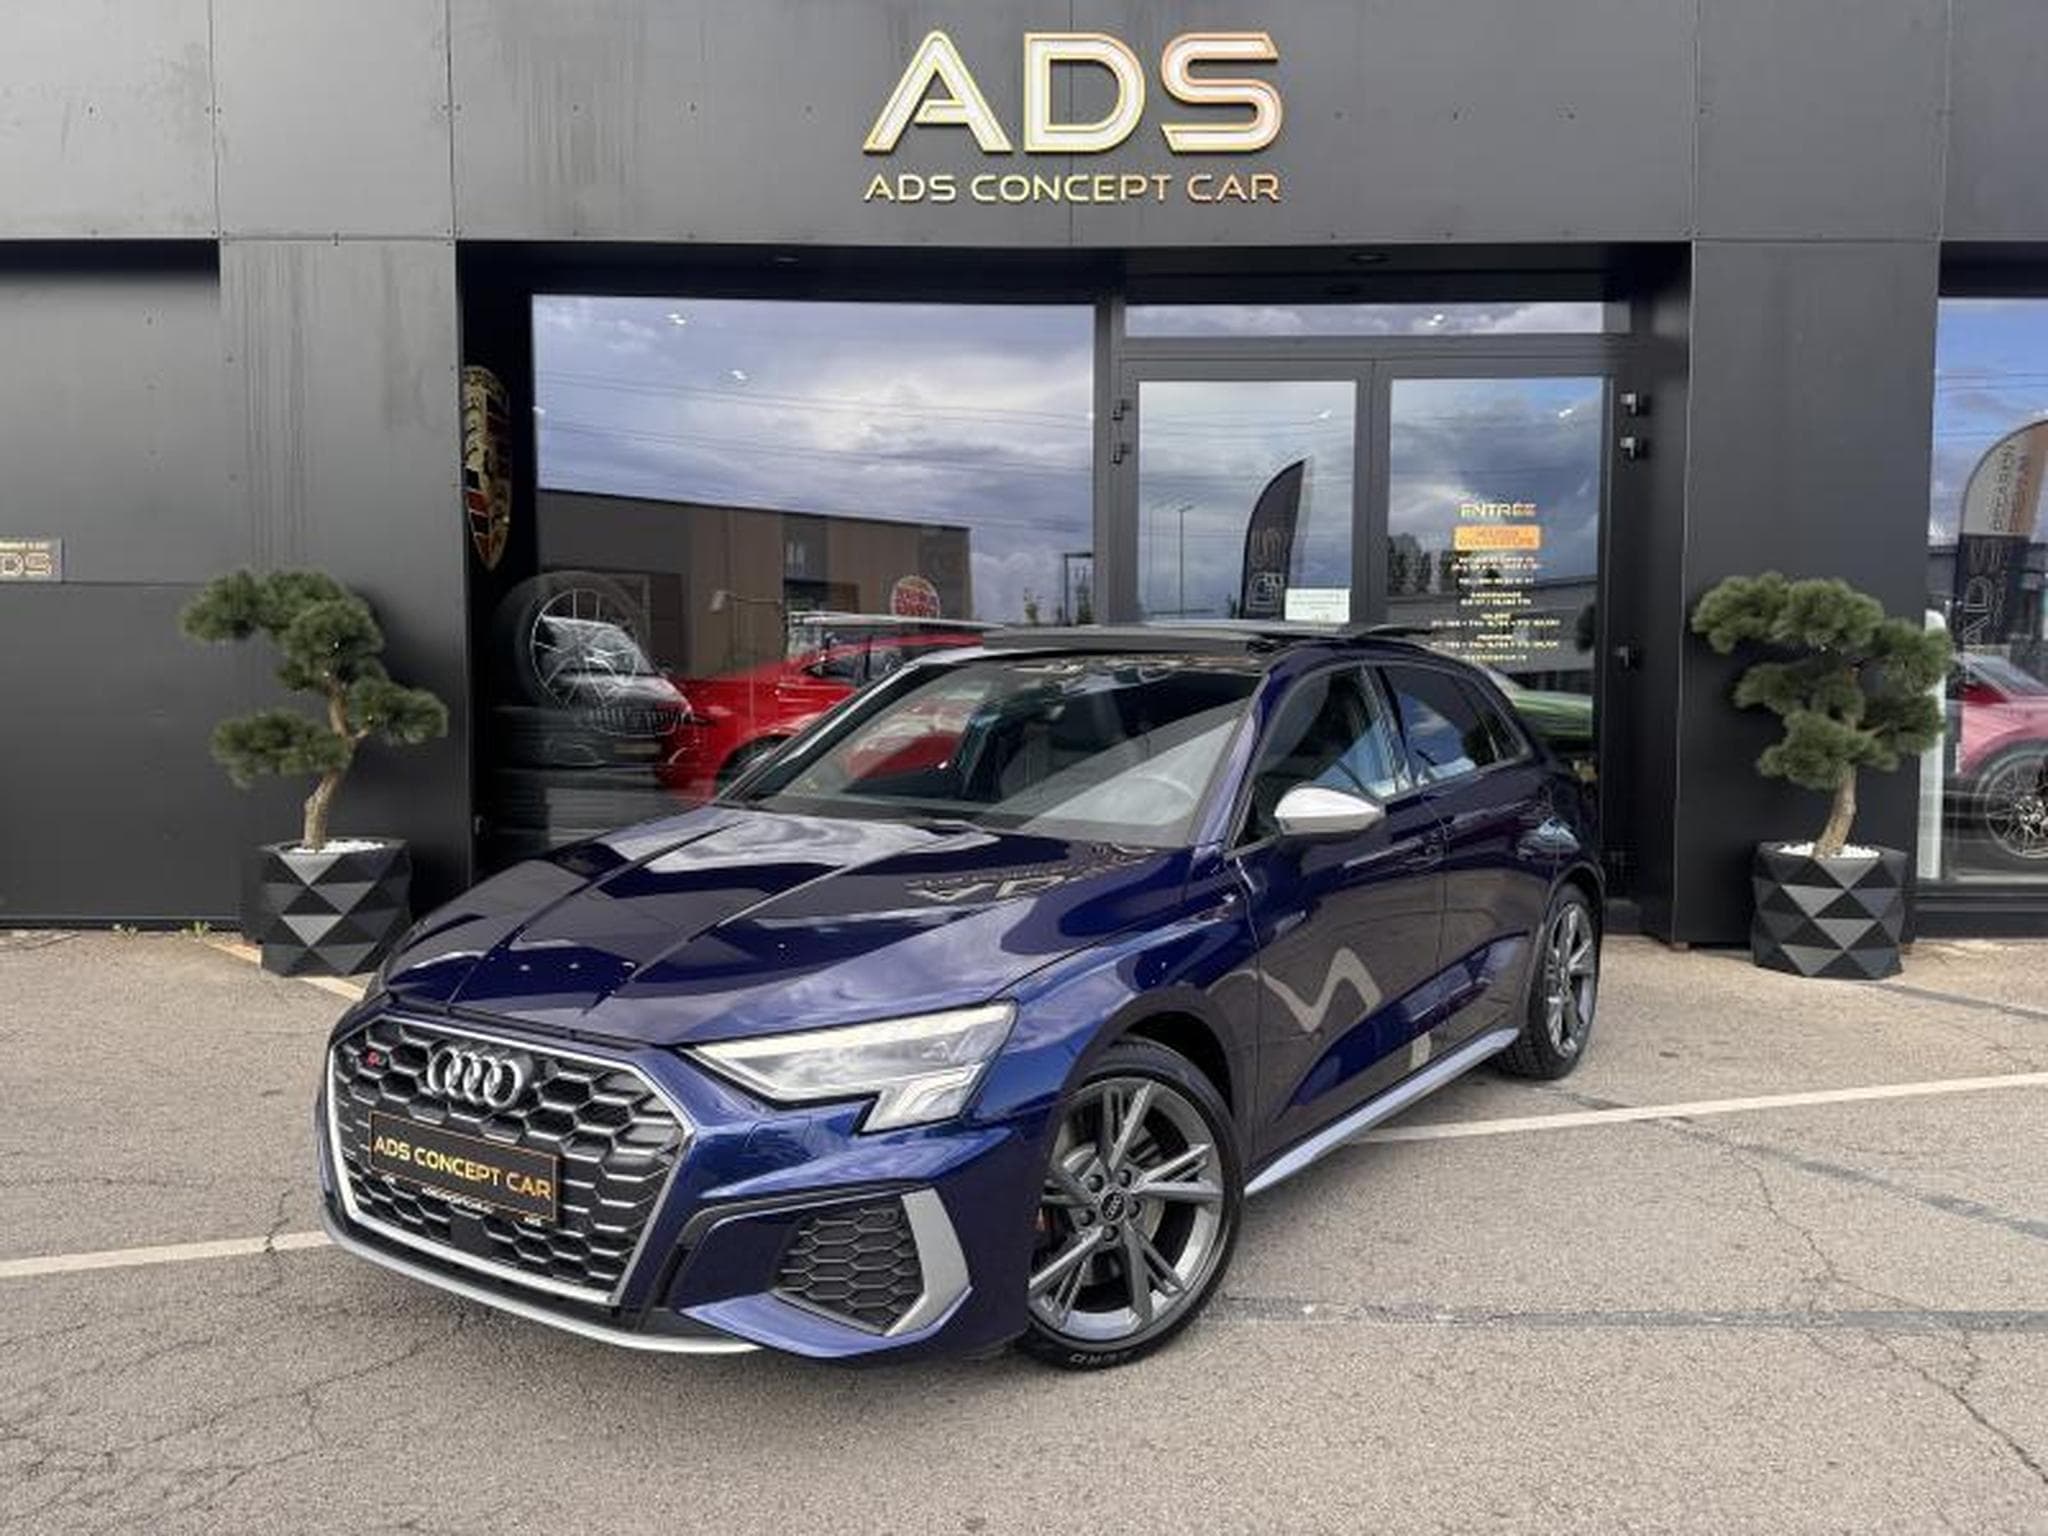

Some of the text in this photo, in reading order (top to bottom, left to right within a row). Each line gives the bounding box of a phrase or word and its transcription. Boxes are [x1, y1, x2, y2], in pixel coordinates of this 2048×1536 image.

[862, 29, 1283, 155] ADS
[864, 173, 1282, 203] ADS CONCEPT CAR
[0, 552, 52, 576] DS
[373, 1135, 411, 1162] ADS
[413, 1147, 502, 1187] CONCEPT
[505, 1172, 552, 1201] CAR
